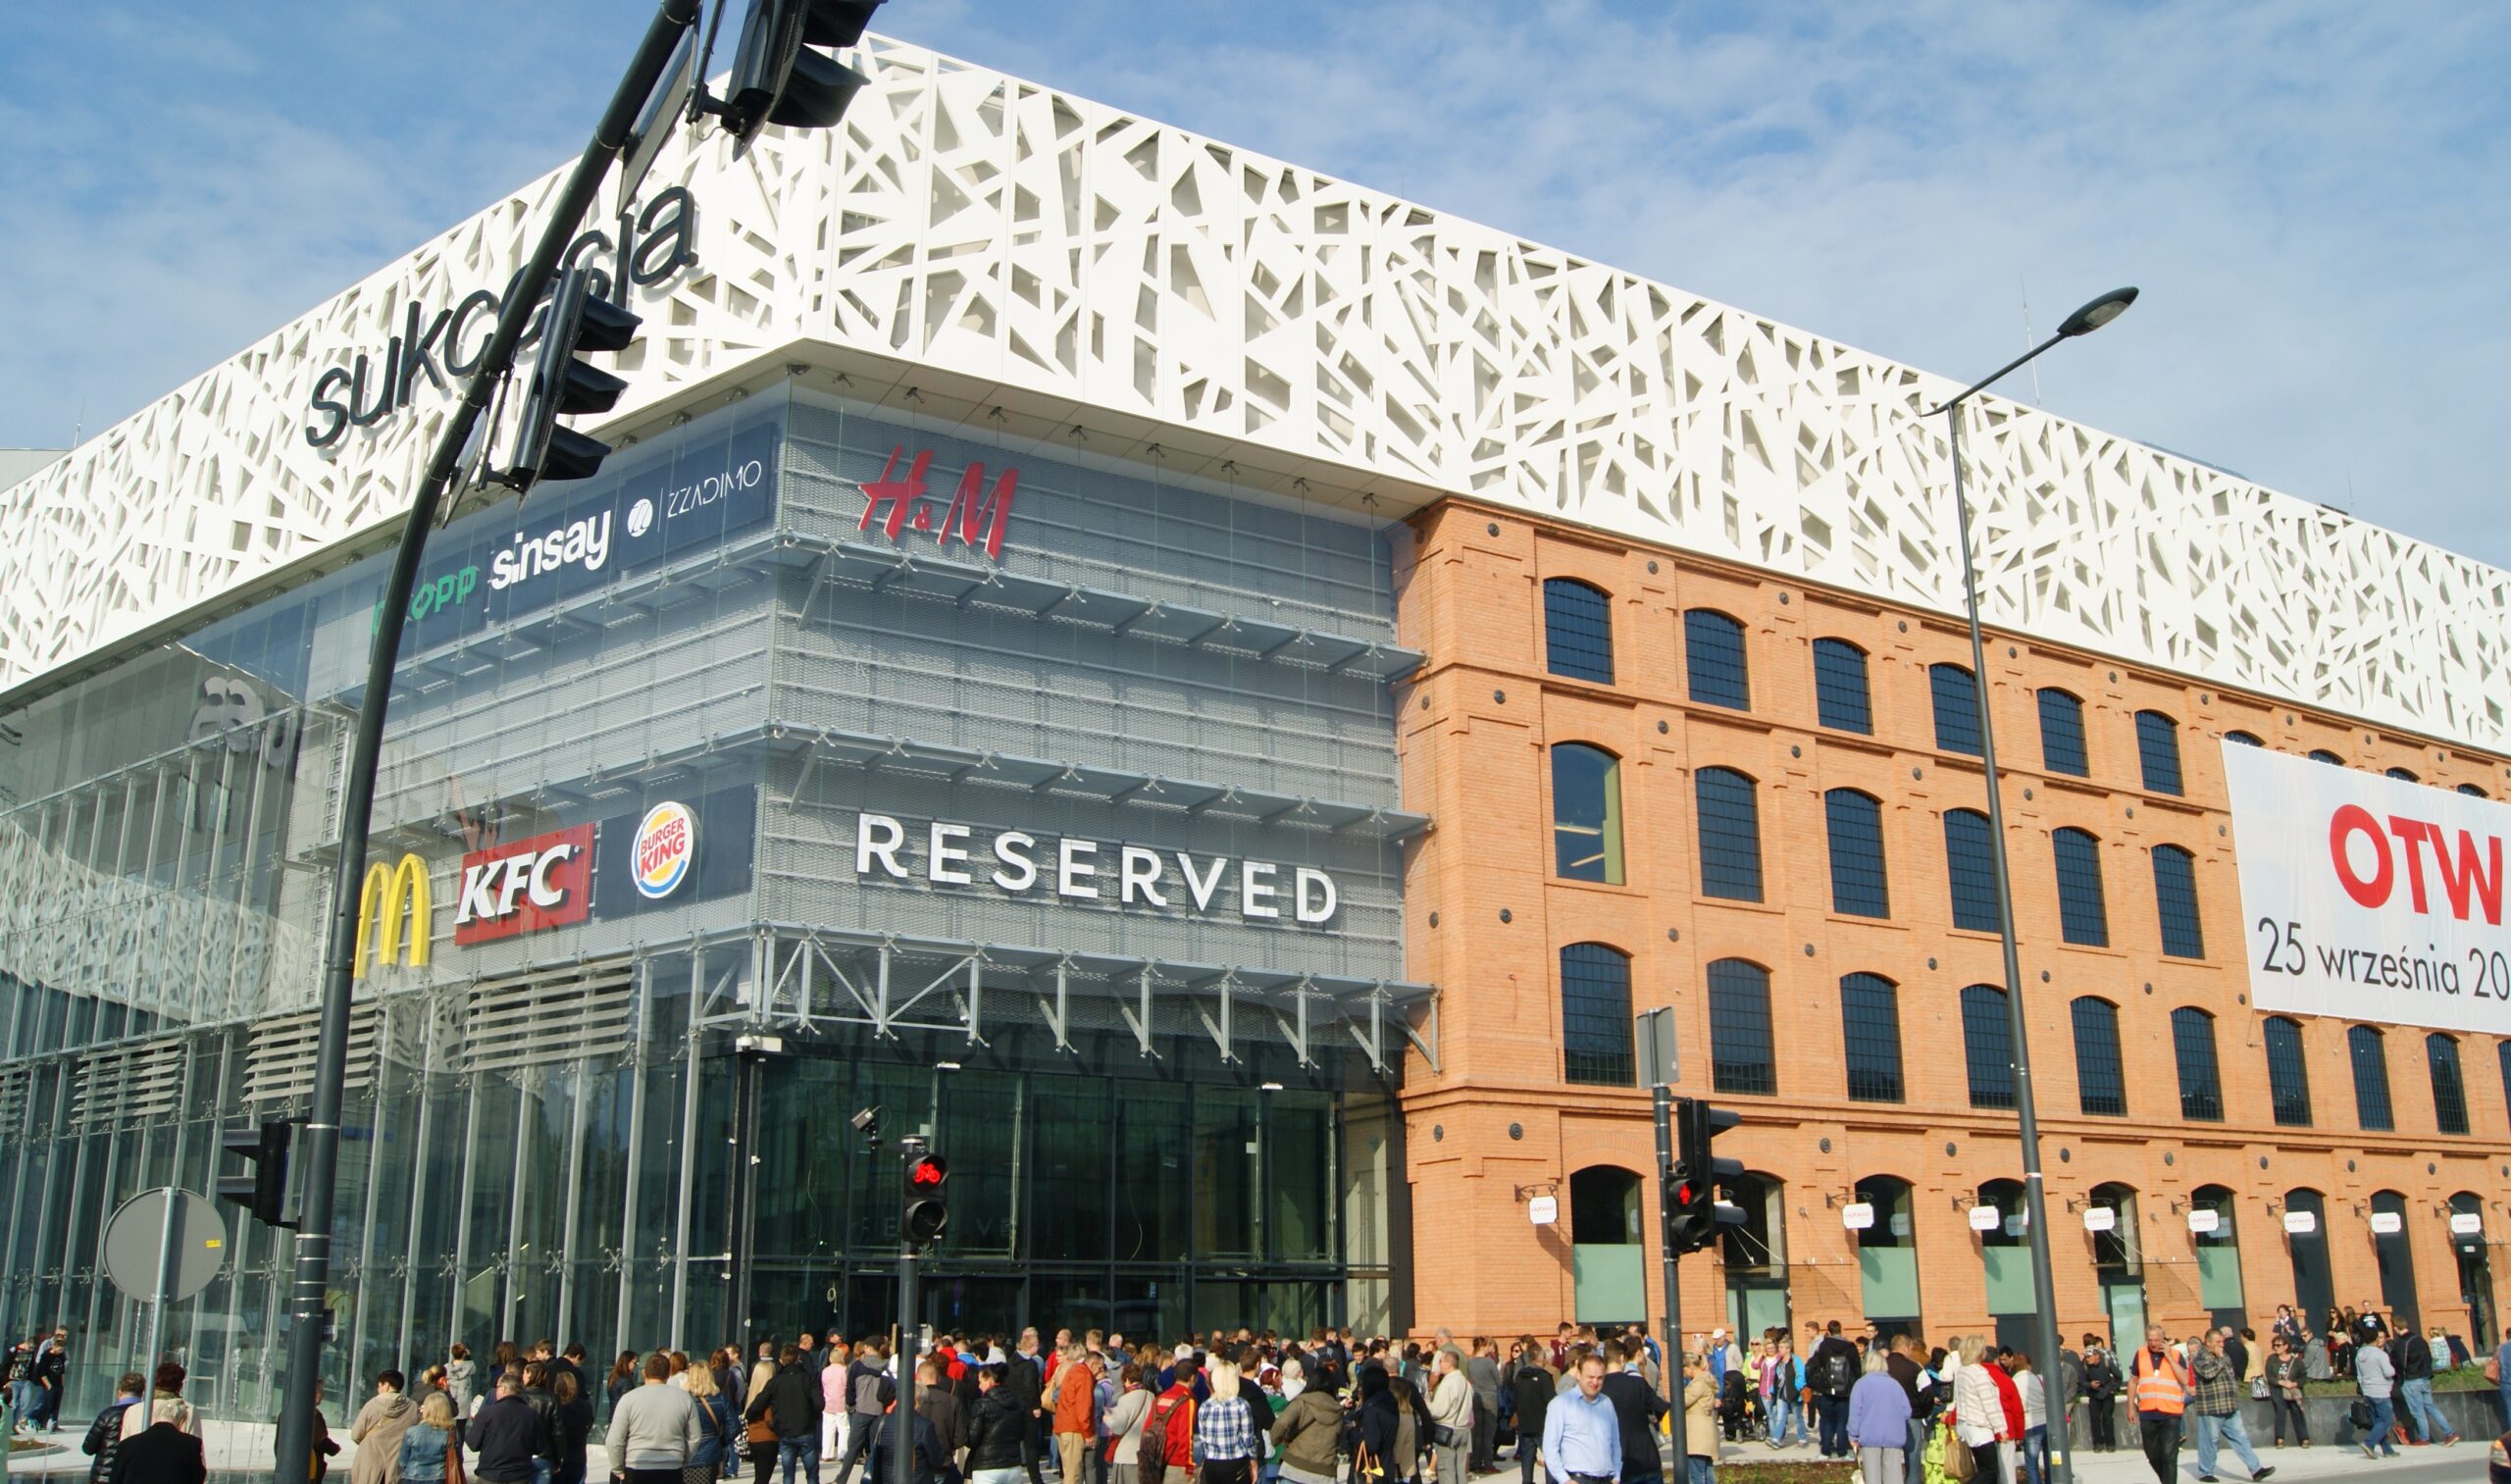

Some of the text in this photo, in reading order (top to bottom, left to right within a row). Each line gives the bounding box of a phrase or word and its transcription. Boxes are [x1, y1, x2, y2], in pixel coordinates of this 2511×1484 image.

[857, 444, 1020, 561] H&M
[491, 509, 612, 590] sinsay
[640, 832, 686, 880] KING
[641, 817, 685, 856] BURGER
[856, 812, 1338, 924] RESERVED
[453, 843, 574, 926] KFC
[2258, 916, 2511, 1001] 25 września 20
